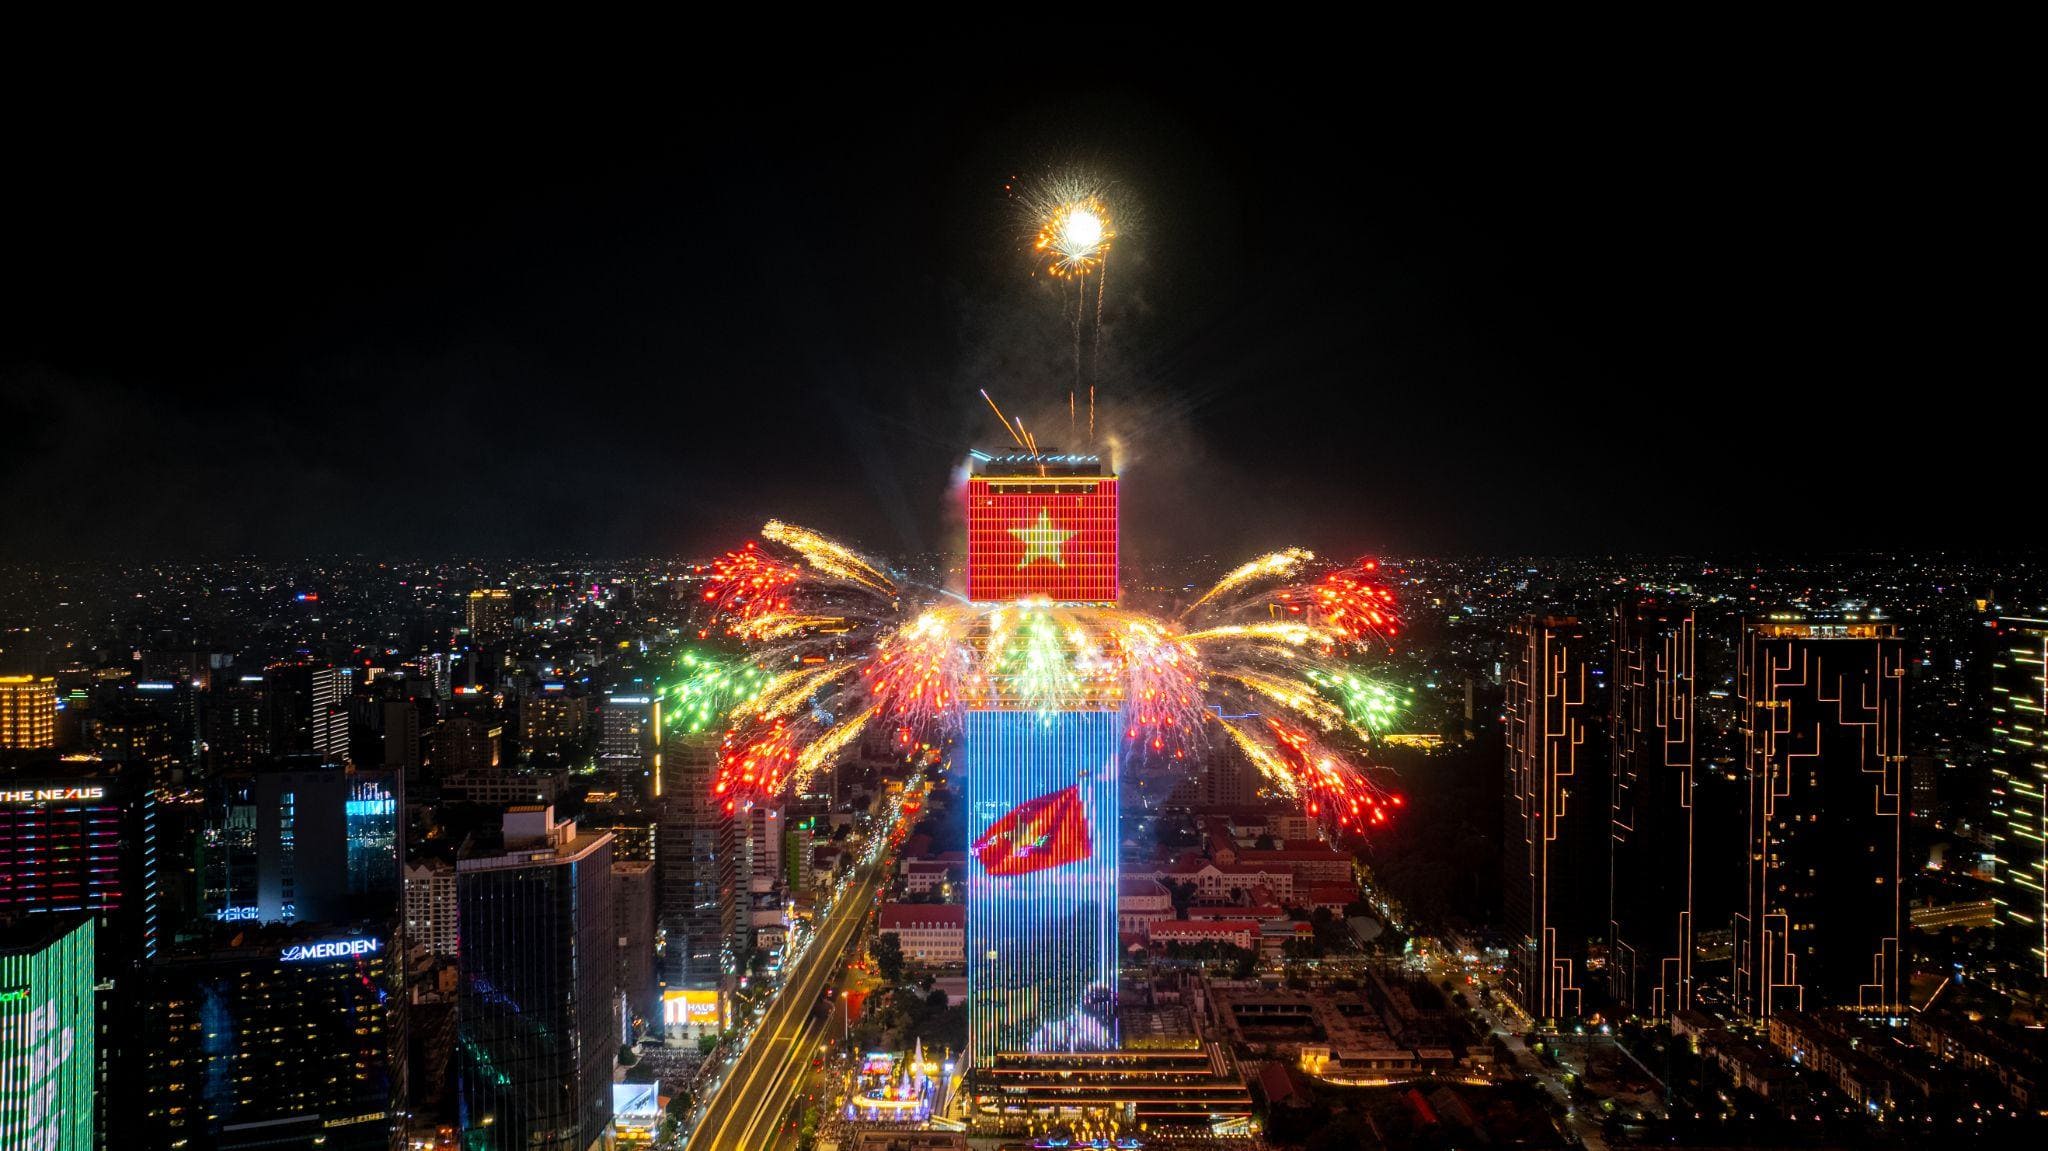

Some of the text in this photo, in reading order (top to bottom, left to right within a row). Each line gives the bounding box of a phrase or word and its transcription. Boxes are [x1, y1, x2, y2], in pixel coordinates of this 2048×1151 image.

[0, 787, 104, 802] THE NEXUS
[301, 938, 377, 959] MERIDIEN
[0, 988, 31, 1002] ank
[687, 1003, 716, 1012] HAUS
